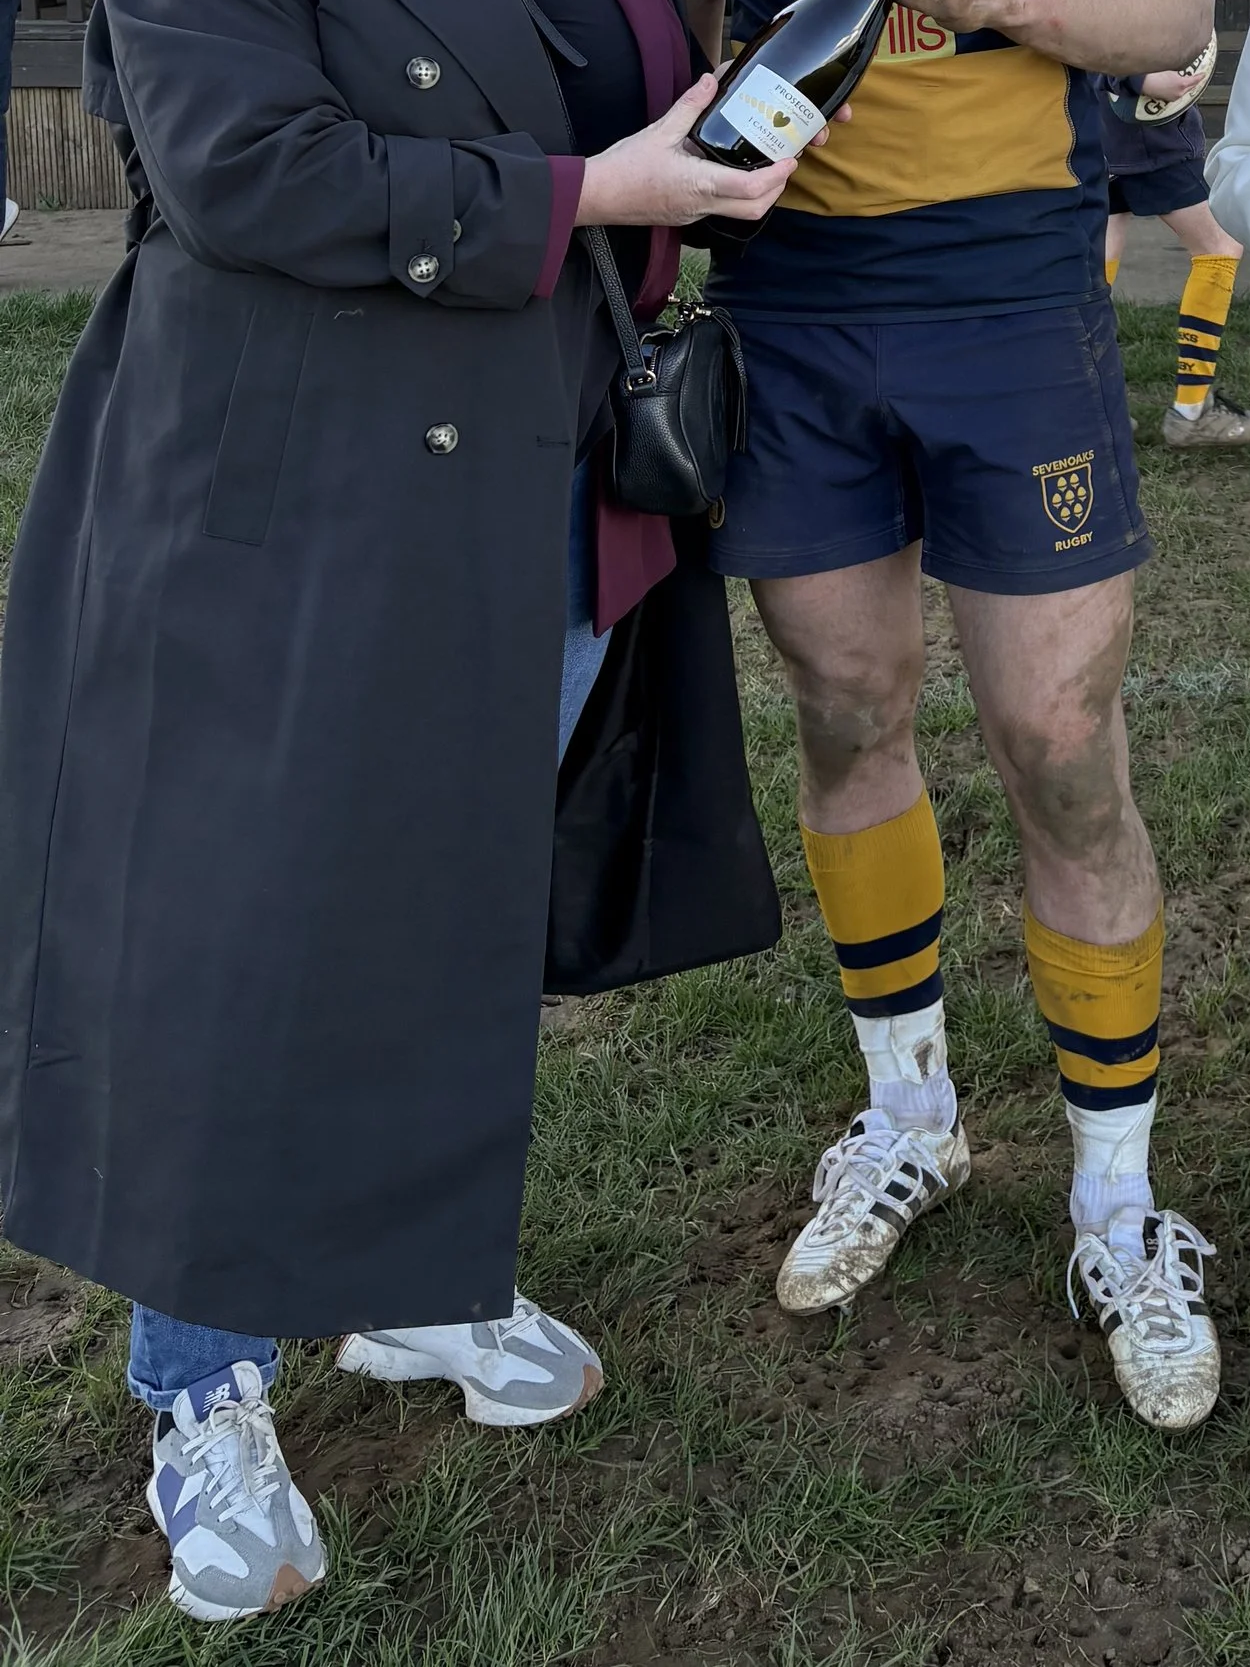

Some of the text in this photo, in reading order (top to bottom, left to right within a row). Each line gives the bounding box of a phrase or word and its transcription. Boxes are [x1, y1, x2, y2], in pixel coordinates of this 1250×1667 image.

[873, 4, 947, 55] ills
[774, 84, 815, 120] PROSECCO
[1032, 449, 1095, 476] SEVENOAKS
[1055, 531, 1094, 552] RUGBY
